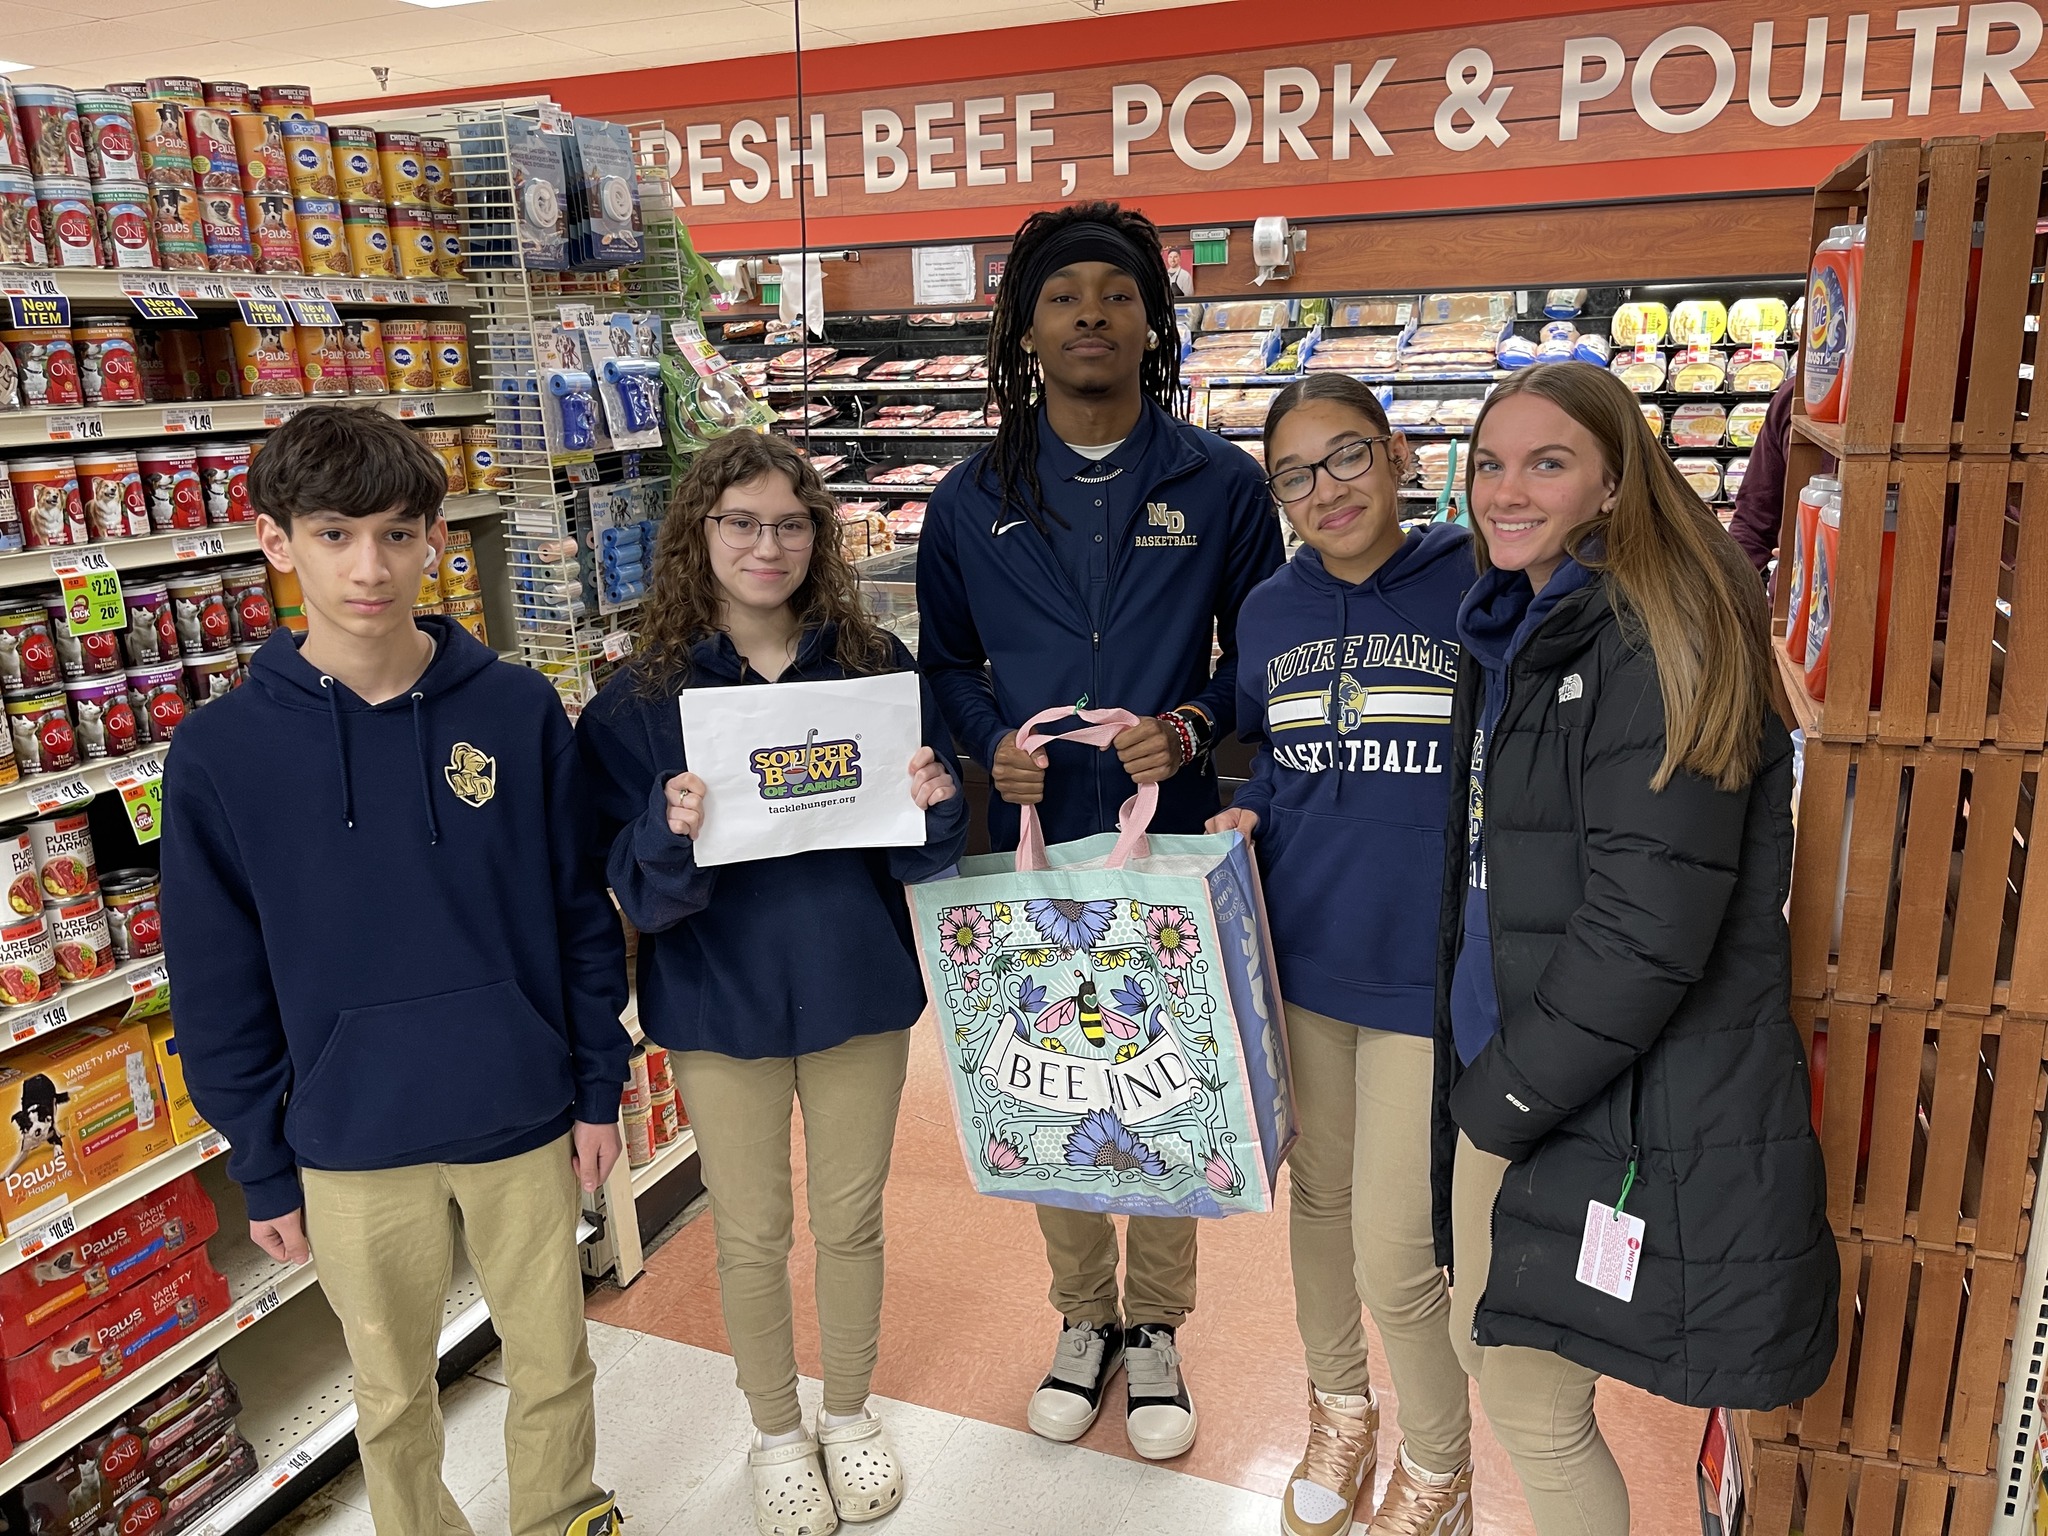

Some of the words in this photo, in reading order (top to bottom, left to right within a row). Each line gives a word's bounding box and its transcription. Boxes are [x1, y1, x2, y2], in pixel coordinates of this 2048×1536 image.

[165, 79, 187, 87] CHOICE
[216, 85, 236, 93] CHOICE
[629, 114, 828, 208] RESH
[861, 92, 1077, 197] BEEF,
[1112, 58, 1397, 175] PORK
[1433, 47, 1514, 151] &
[1559, 1, 2044, 141] POULTR
[339, 129, 359, 137] CHOICE
[556, 119, 573, 135] $3.99
[102, 136, 131, 151] ONE
[155, 135, 188, 149] Paws
[390, 134, 409, 142] CHOICE
[60, 222, 90, 238] ONE
[116, 224, 145, 239] ONE
[154, 221, 190, 233] Paws
[205, 224, 241, 236] Paws
[259, 226, 292, 239] Paws
[22, 299, 57, 312] New
[142, 298, 176, 308] New
[433, 291, 450, 304] $1.89
[147, 306, 187, 317] ITEM
[248, 301, 277, 313] New
[298, 302, 325, 313] New
[24, 312, 62, 325] ITEM
[251, 313, 284, 323] ITEM
[302, 313, 333, 323] ITEM
[577, 311, 595, 328] $6.99
[256, 350, 290, 361] Paws
[51, 361, 77, 376] ONE
[105, 360, 134, 375] ONE
[77, 420, 104, 438] $2.49
[189, 414, 211, 431] $2.49
[581, 467, 598, 481] $8.49
[177, 489, 201, 504] ONE
[1147, 502, 1185, 534] ND
[200, 539, 223, 556] $2.49
[1134, 535, 1198, 547] BASKETBALL
[81, 554, 109, 570] $2.49
[91, 578, 117, 597] $2.29
[70, 609, 91, 619] LOCK
[100, 606, 120, 620] 20¢
[243, 604, 269, 619] ONE
[205, 614, 228, 629] ONE
[87, 635, 114, 649] ONE
[26, 646, 54, 662] ONE
[1267, 635, 1364, 694] NOTRE
[1363, 633, 1461, 683] DAME
[154, 703, 183, 719] ONE
[109, 715, 133, 731] ONE
[45, 731, 72, 746] ONE
[754, 743, 856, 769] SOUPER
[137, 760, 163, 778] $2.49
[61, 781, 90, 799] $2.49
[451, 773, 495, 801] ND
[764, 786, 787, 797] OF
[791, 777, 858, 794] CARING
[768, 796, 856, 814] tacklehunger.org
[135, 816, 154, 829] LOCK
[45, 831, 79, 846] PURE
[1214, 886, 1233, 911] 100%
[52, 916, 88, 931] PURE
[133, 917, 162, 936] ONE
[43, 1006, 68, 1027] $1.99
[63, 1055, 104, 1080] VARIETY
[106, 1041, 131, 1060] PACK
[1008, 1053, 1088, 1101] BEE
[76, 1111, 83, 1119] 3
[81, 1128, 87, 1137] 3
[85, 1146, 91, 1155] 3
[145, 1144, 152, 1152] 12
[5, 1153, 67, 1197] Paws
[28, 1179, 56, 1199] Happy
[57, 1170, 73, 1185] Life
[137, 1193, 178, 1221] VARIETY
[49, 1216, 75, 1239] $10.99
[139, 1211, 166, 1232] PACK
[80, 1227, 128, 1260] Paws
[97, 1245, 119, 1259] Happy
[111, 1267, 117, 1276] 6
[1624, 1250, 1636, 1282] NOTICE
[151, 1270, 192, 1301] VARIETY
[153, 1289, 179, 1311] PACK
[256, 1291, 280, 1315] $20.99
[97, 1307, 142, 1344] Paws
[126, 1348, 132, 1356] 6
[104, 1440, 138, 1472] ONE
[289, 1451, 312, 1470] $14.99
[113, 1470, 145, 1496] INSTINCT
[119, 1469, 136, 1486] TRUE
[69, 1516, 80, 1529] 12
[80, 1501, 102, 1521] COUNT
[124, 1503, 158, 1533] ONE
